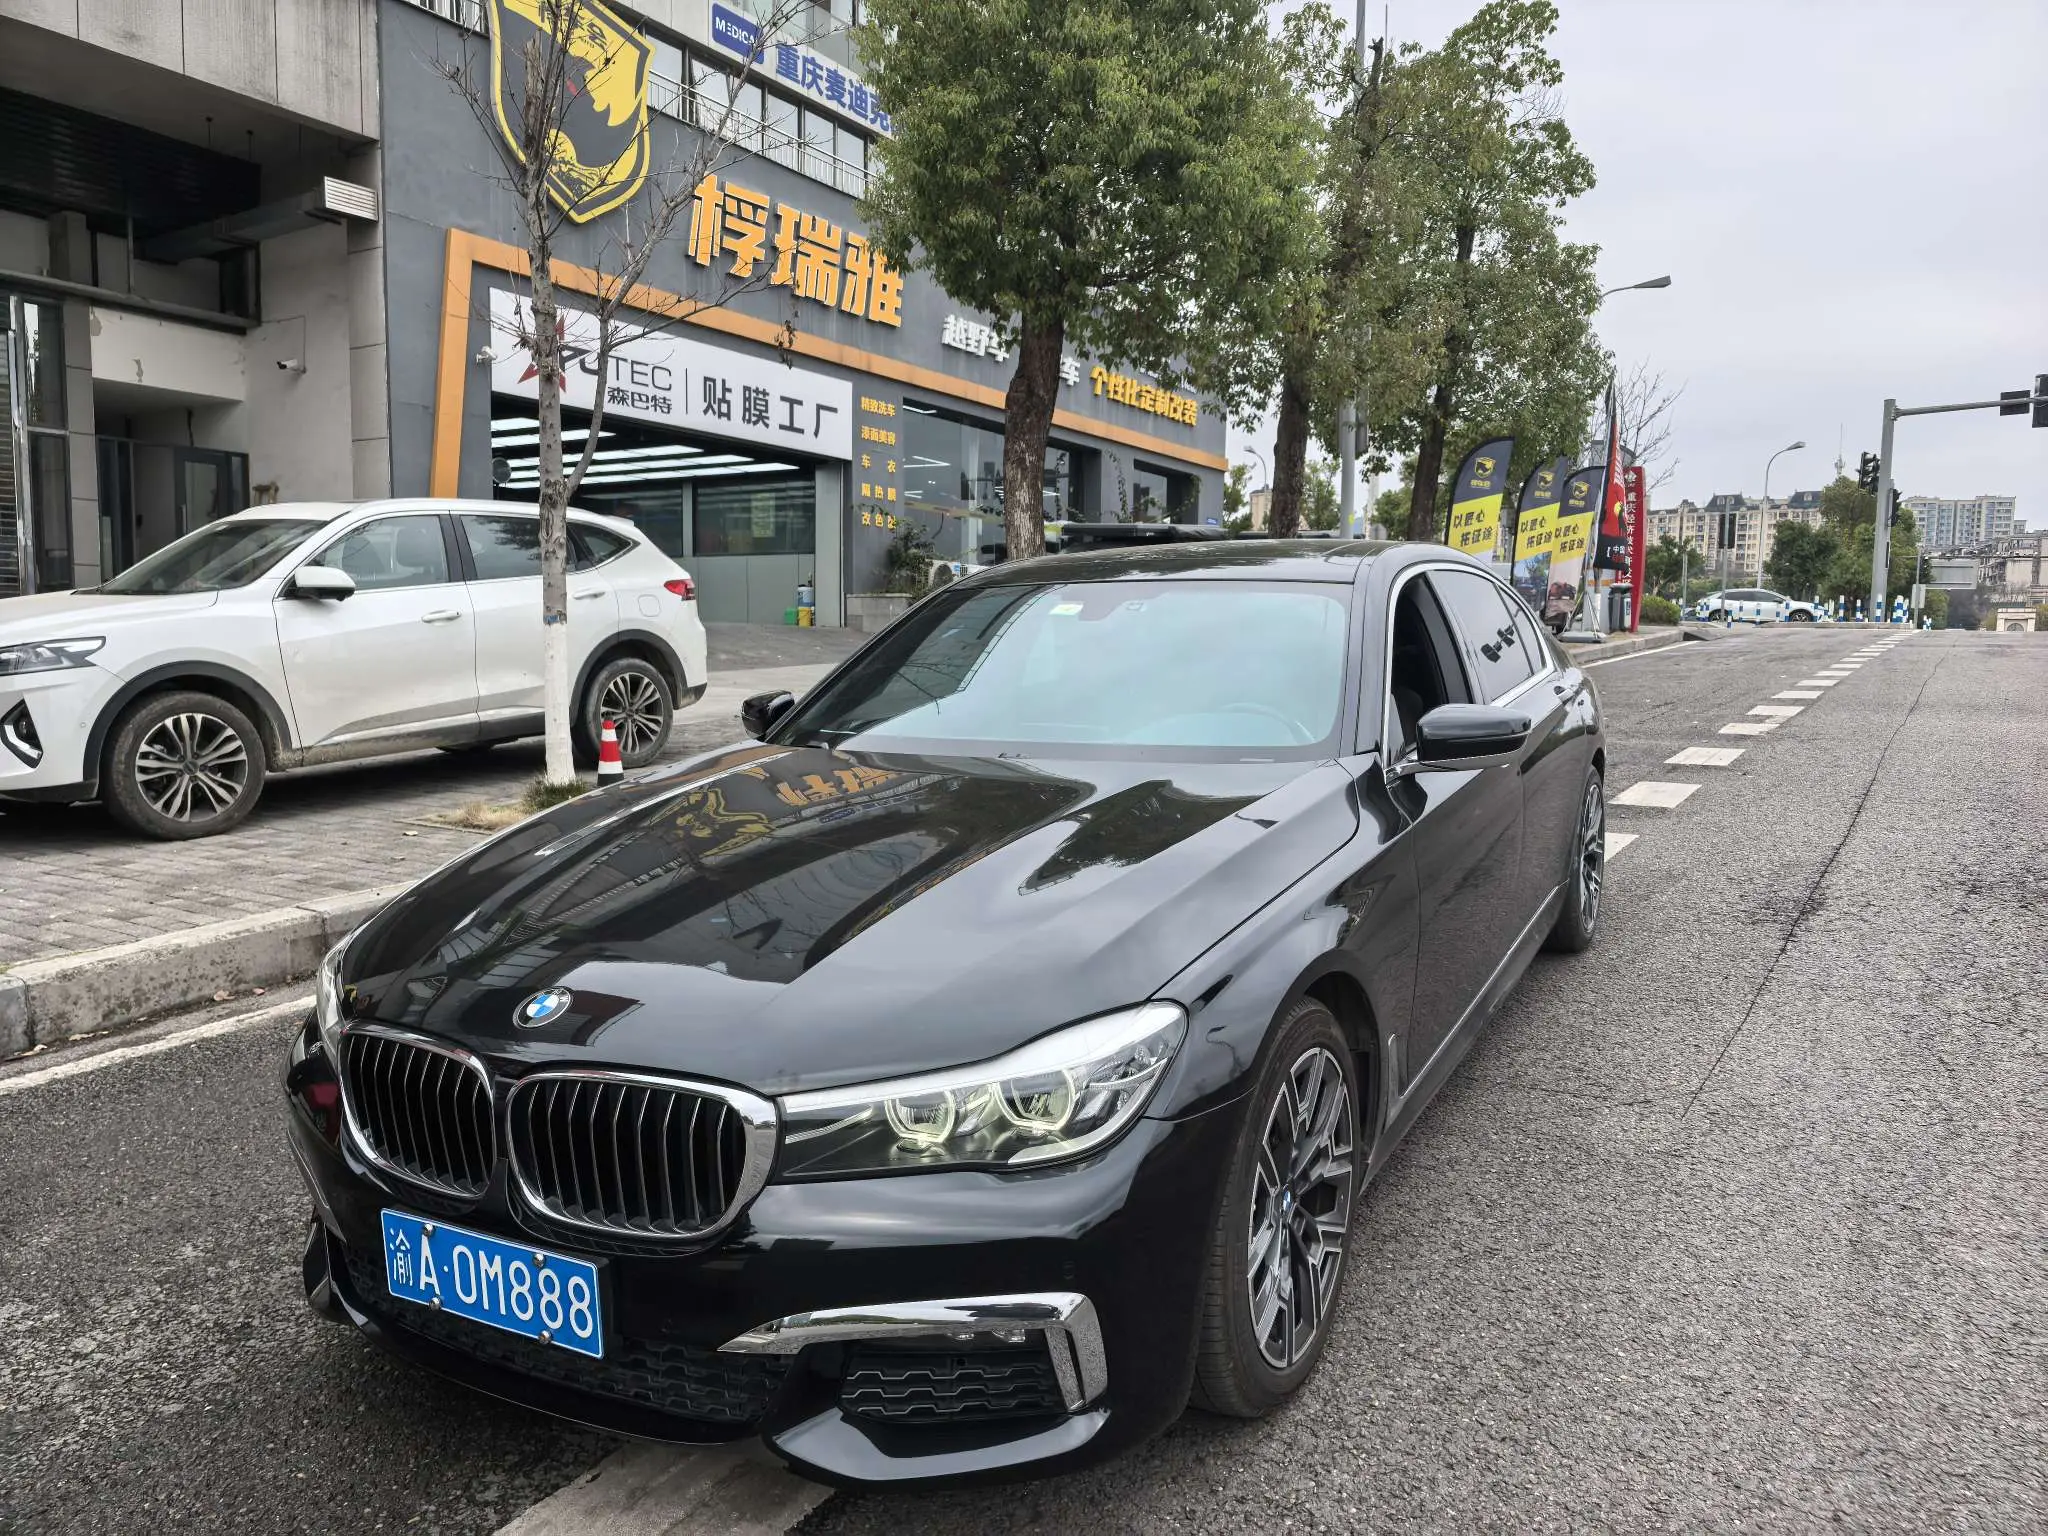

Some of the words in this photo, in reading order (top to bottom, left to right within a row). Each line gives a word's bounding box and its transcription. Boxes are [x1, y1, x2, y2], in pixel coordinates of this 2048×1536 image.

[715, 16, 758, 46] MEDICA
[776, 43, 893, 131] 重庆麦迪克
[607, 386, 673, 415] 森巴特
[702, 375, 839, 440] 贴膜工厂
[1090, 366, 1198, 426] 个性化定制改装
